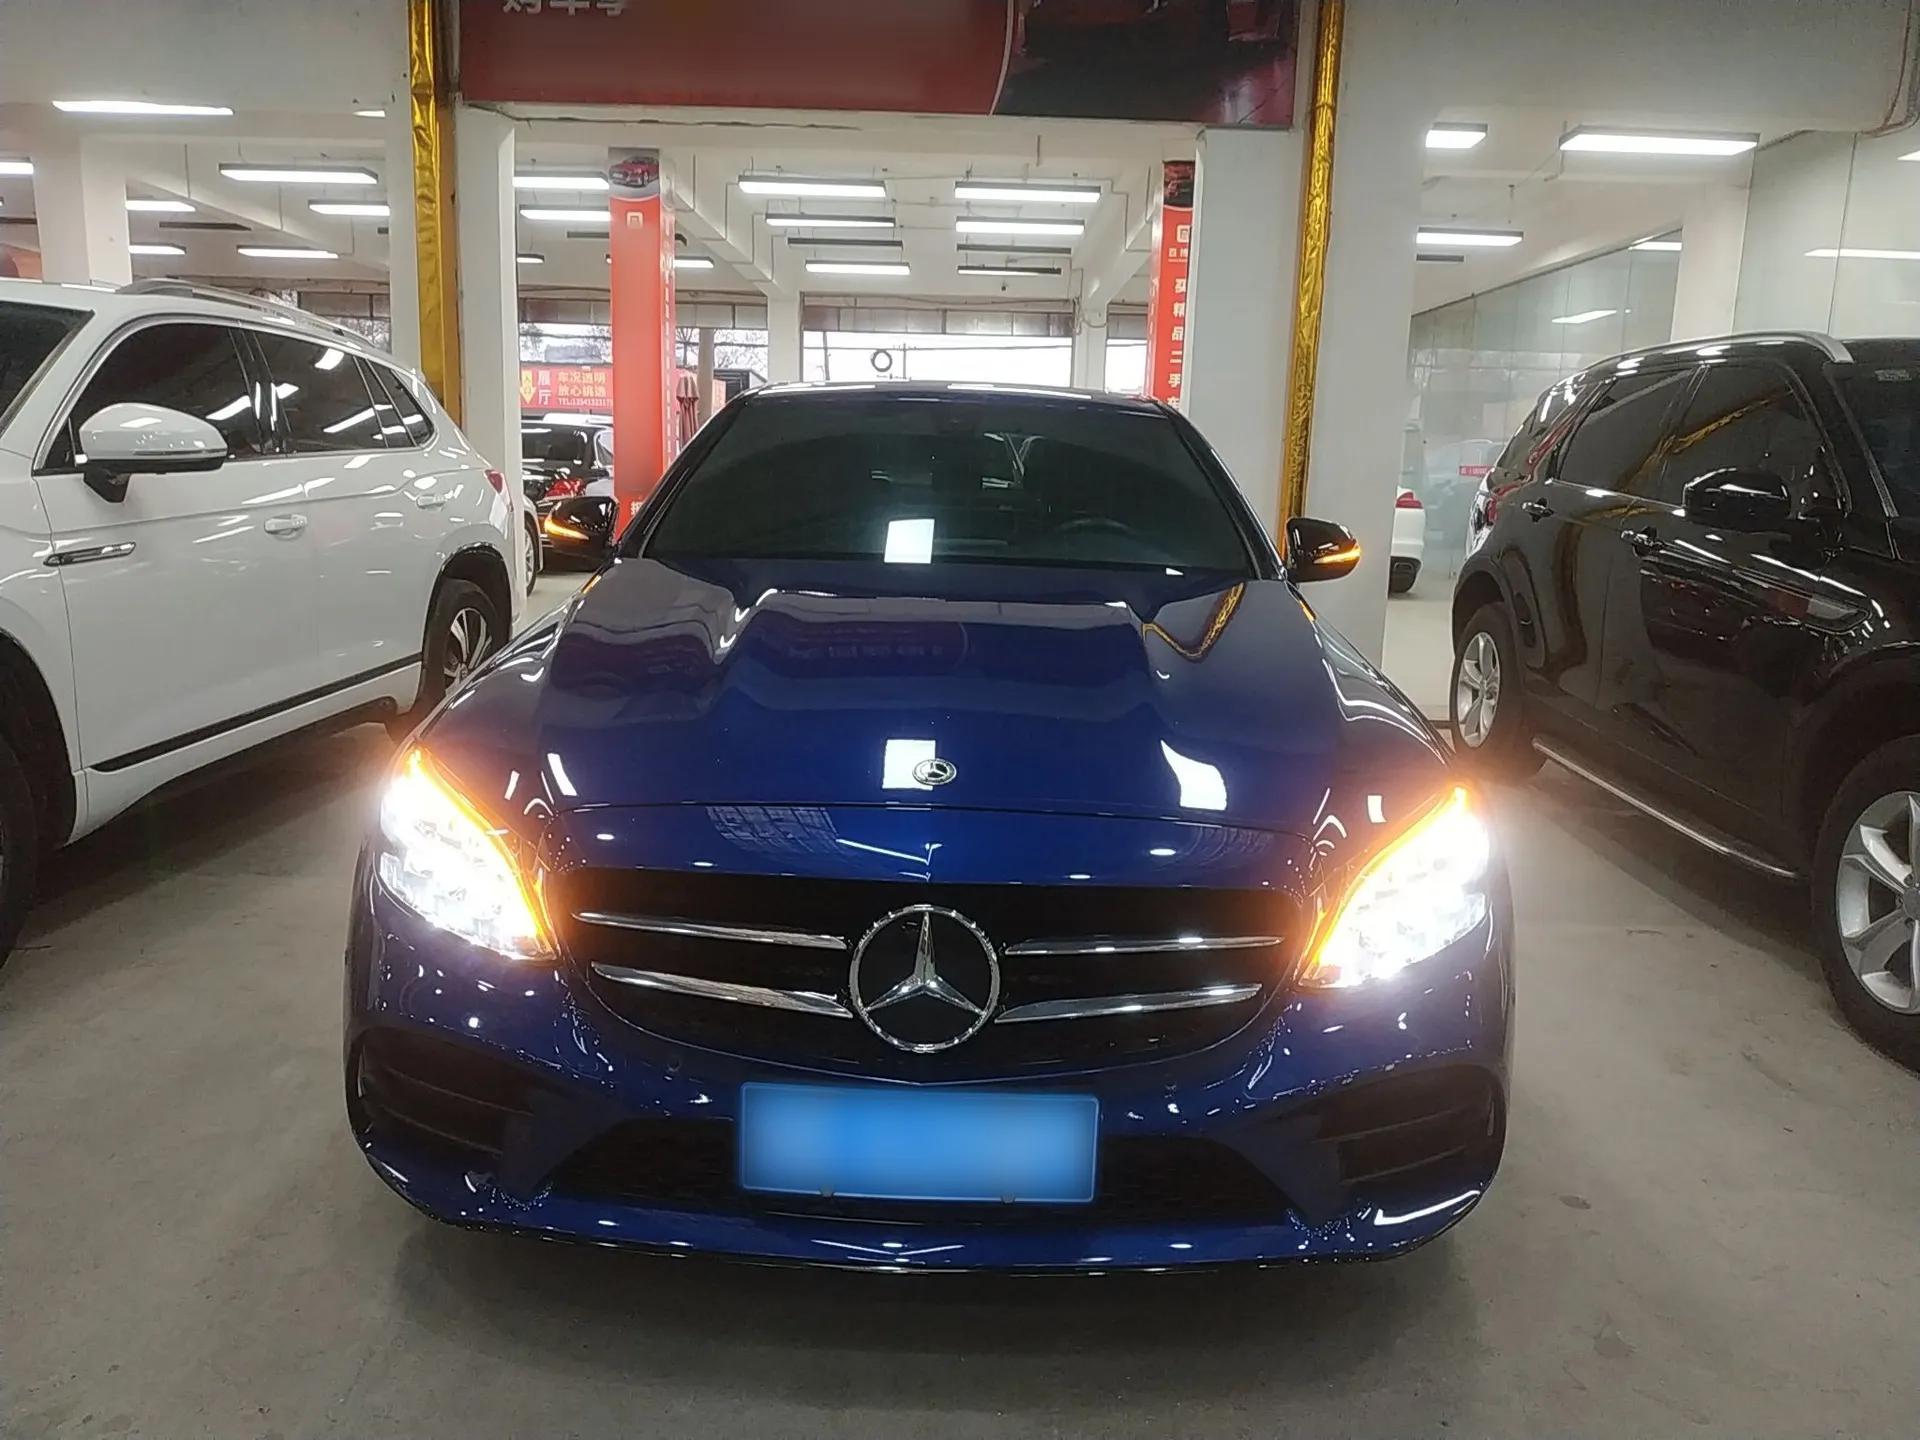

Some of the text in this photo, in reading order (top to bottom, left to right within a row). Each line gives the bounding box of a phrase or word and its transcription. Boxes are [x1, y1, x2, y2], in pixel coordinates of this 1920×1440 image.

[538, 370, 551, 405] 展厅
[558, 371, 606, 384] 车况透明
